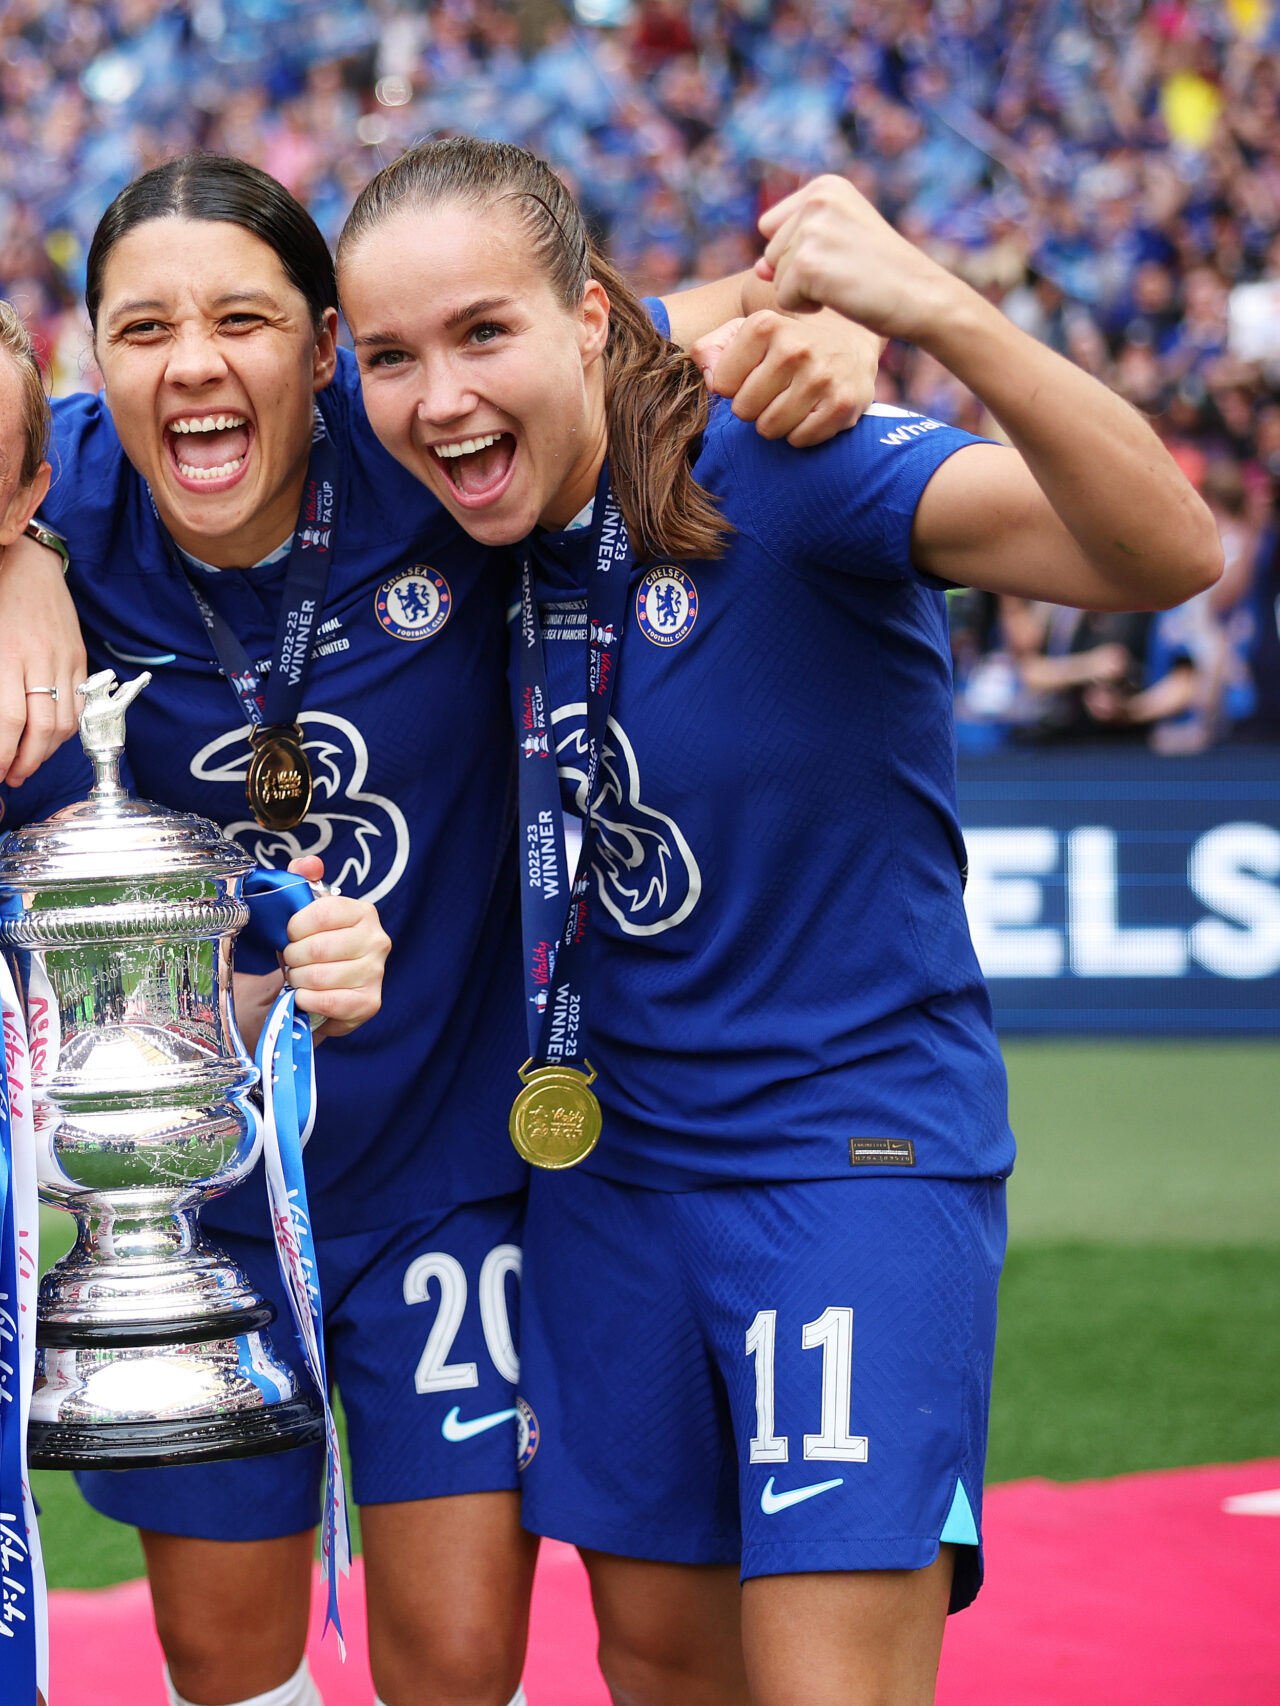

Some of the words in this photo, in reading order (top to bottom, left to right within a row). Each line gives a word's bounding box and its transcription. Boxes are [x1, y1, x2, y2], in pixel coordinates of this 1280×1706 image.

[879, 418, 951, 446] Whal
[323, 481, 333, 507] CUP
[322, 509, 333, 523] FA
[382, 567, 428, 592] CHELSEA
[646, 568, 685, 586] CHELSEA
[279, 611, 299, 674] 2022-23
[288, 600, 316, 686] WINNER
[318, 638, 350, 657] UNITED
[647, 628, 674, 642] FOOTBALL
[675, 626, 688, 639] CLUB
[590, 649, 597, 664] FA
[243, 699, 254, 714] FA
[534, 685, 544, 711] CUP
[537, 712, 546, 728] FA
[527, 824, 542, 887] 2022-23
[538, 810, 559, 900] WINNER
[565, 920, 574, 945] CUP
[530, 941, 552, 984] Vitality
[545, 983, 570, 1064] WINNER
[564, 994, 580, 1056] 2022-23
[2, 1010, 26, 1121] Vitalit
[403, 1243, 523, 1395] 20
[745, 1306, 869, 1464] 11
